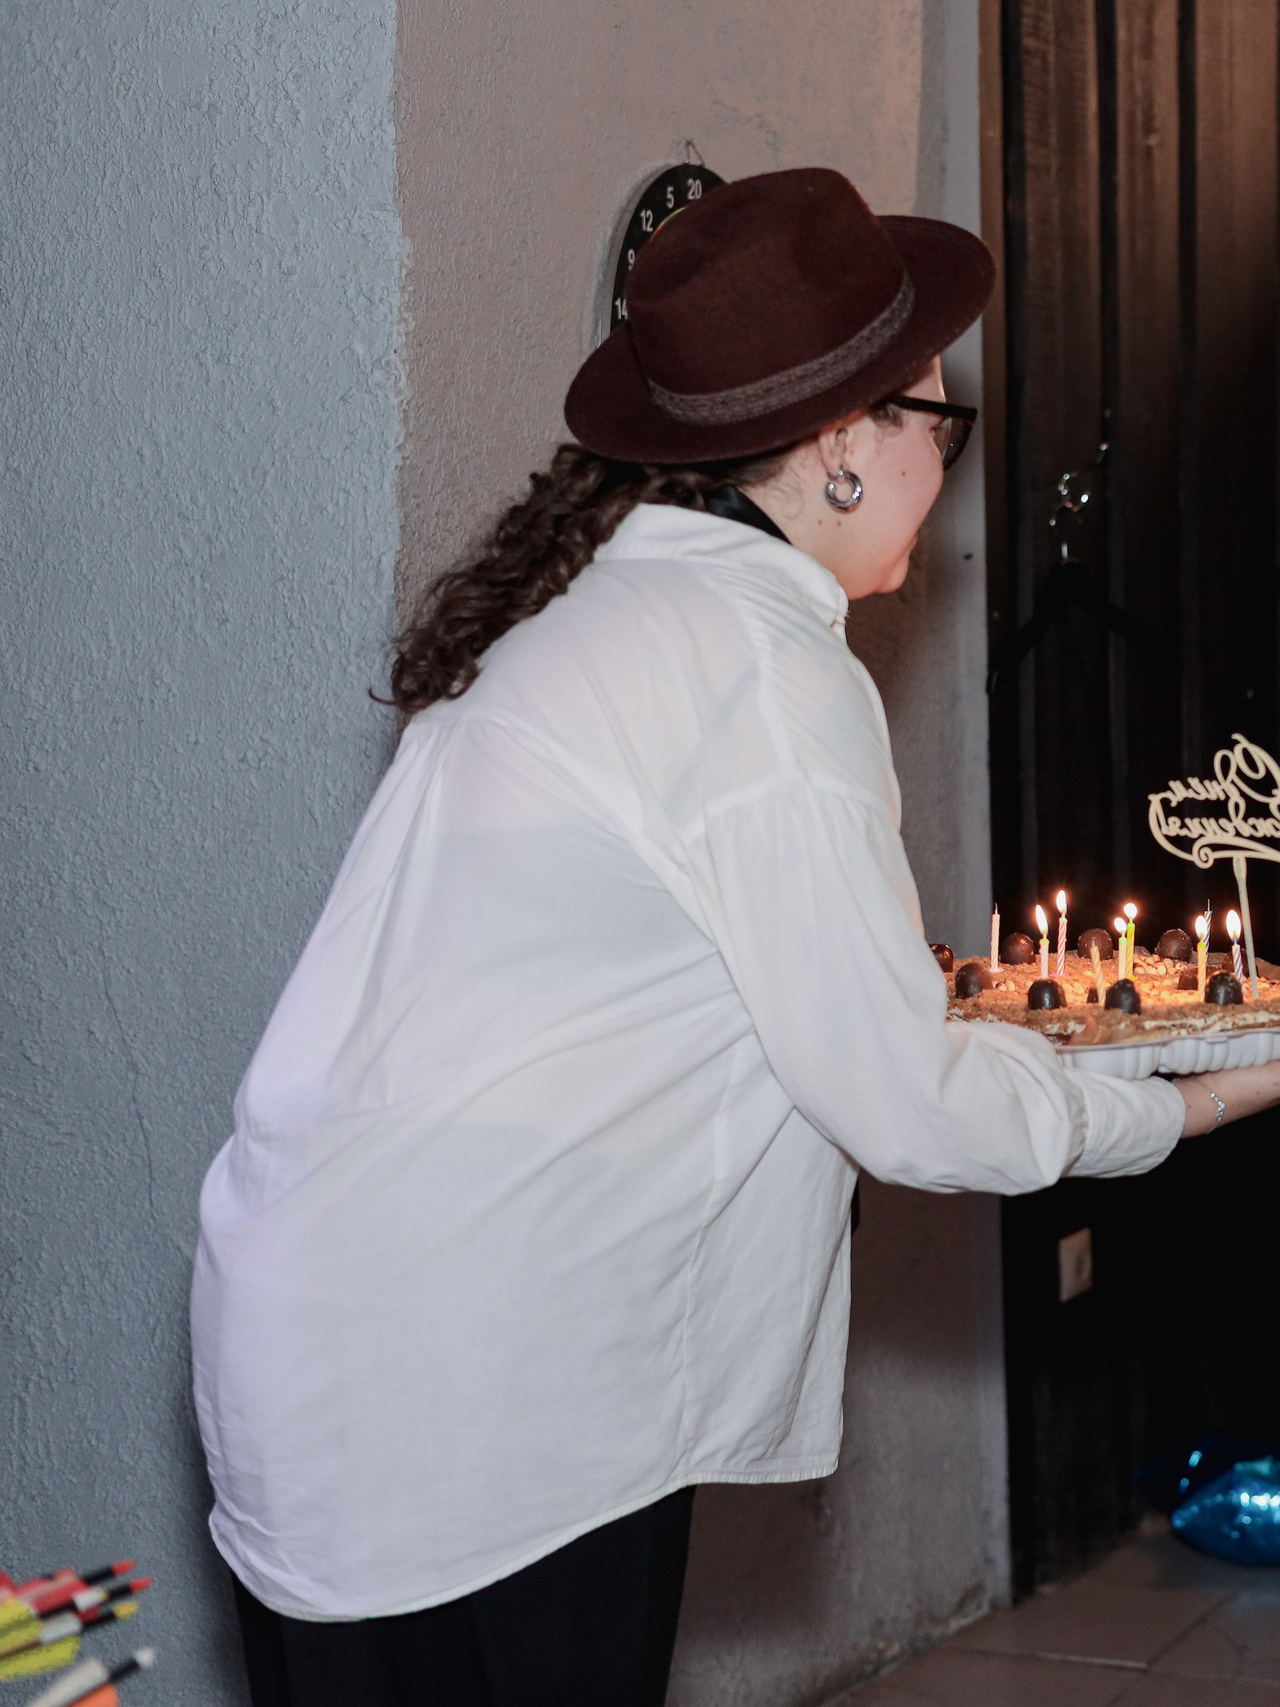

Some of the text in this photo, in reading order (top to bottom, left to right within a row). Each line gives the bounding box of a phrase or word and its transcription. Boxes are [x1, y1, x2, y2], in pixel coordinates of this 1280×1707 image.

[665, 185, 675, 209] 5
[686, 178, 703, 200] 20
[639, 209, 654, 232] 12
[627, 248, 636, 271] 9
[614, 297, 629, 320] 14
